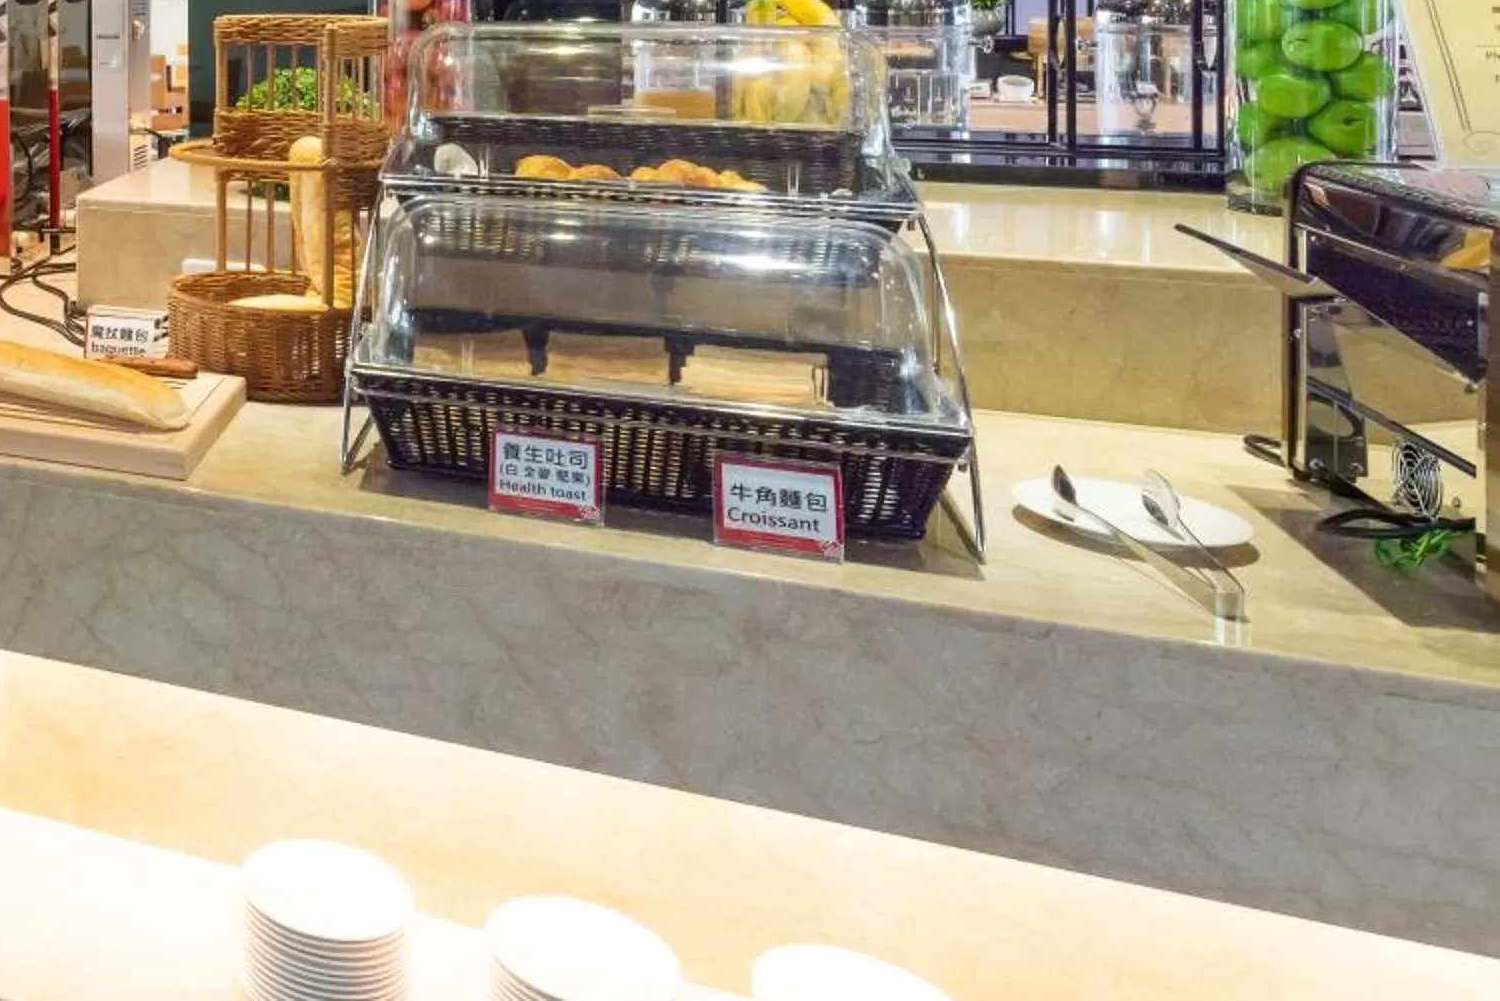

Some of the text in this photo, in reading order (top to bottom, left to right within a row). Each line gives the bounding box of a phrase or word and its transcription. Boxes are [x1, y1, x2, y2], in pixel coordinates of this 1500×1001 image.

[503, 441, 589, 470] 養生吐司
[499, 478, 587, 501] Health toast
[729, 482, 828, 513] 牛角麵包
[727, 506, 821, 533] Croissant
